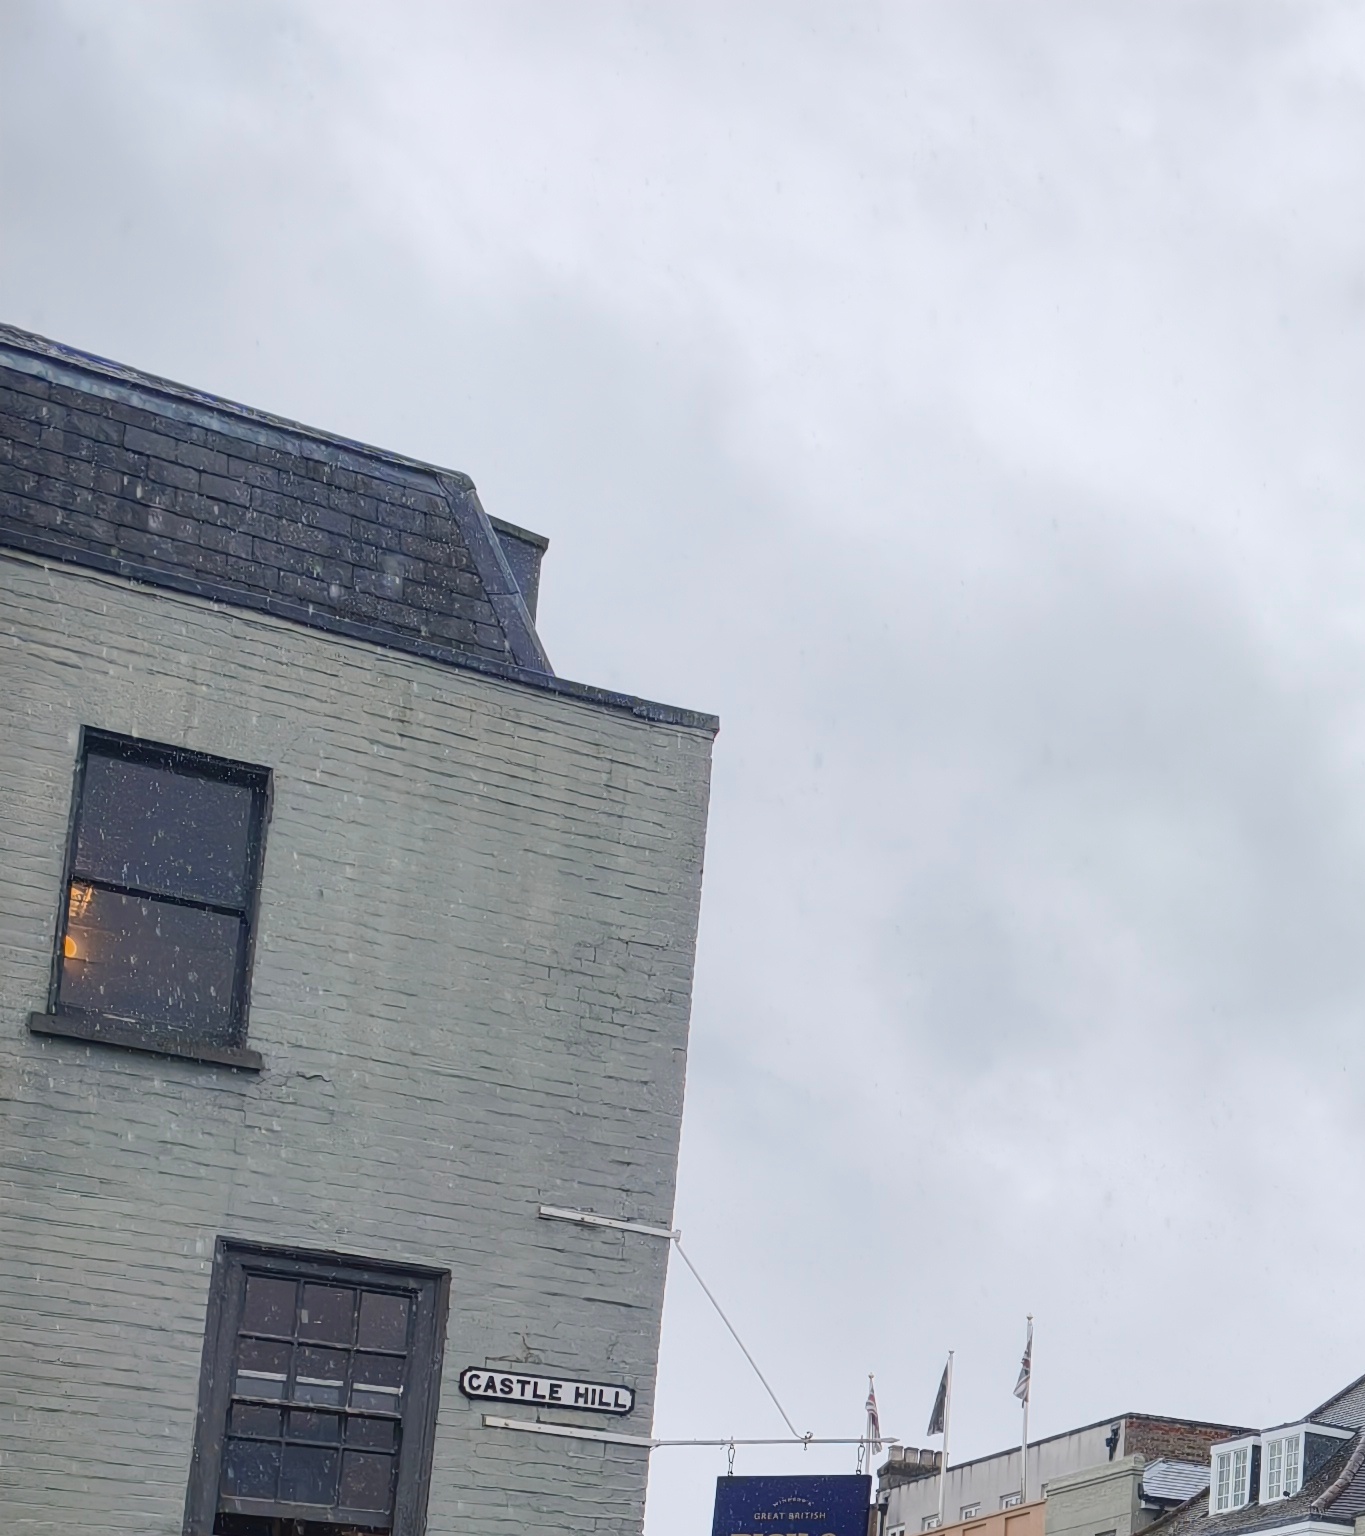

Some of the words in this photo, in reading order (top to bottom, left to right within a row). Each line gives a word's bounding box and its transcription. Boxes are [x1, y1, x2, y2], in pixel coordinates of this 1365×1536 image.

[468, 1374, 563, 1402] CASTLE
[574, 1386, 627, 1409] HILL
[754, 1512, 785, 1520] GREAT
[788, 1512, 826, 1520] BRITISH
